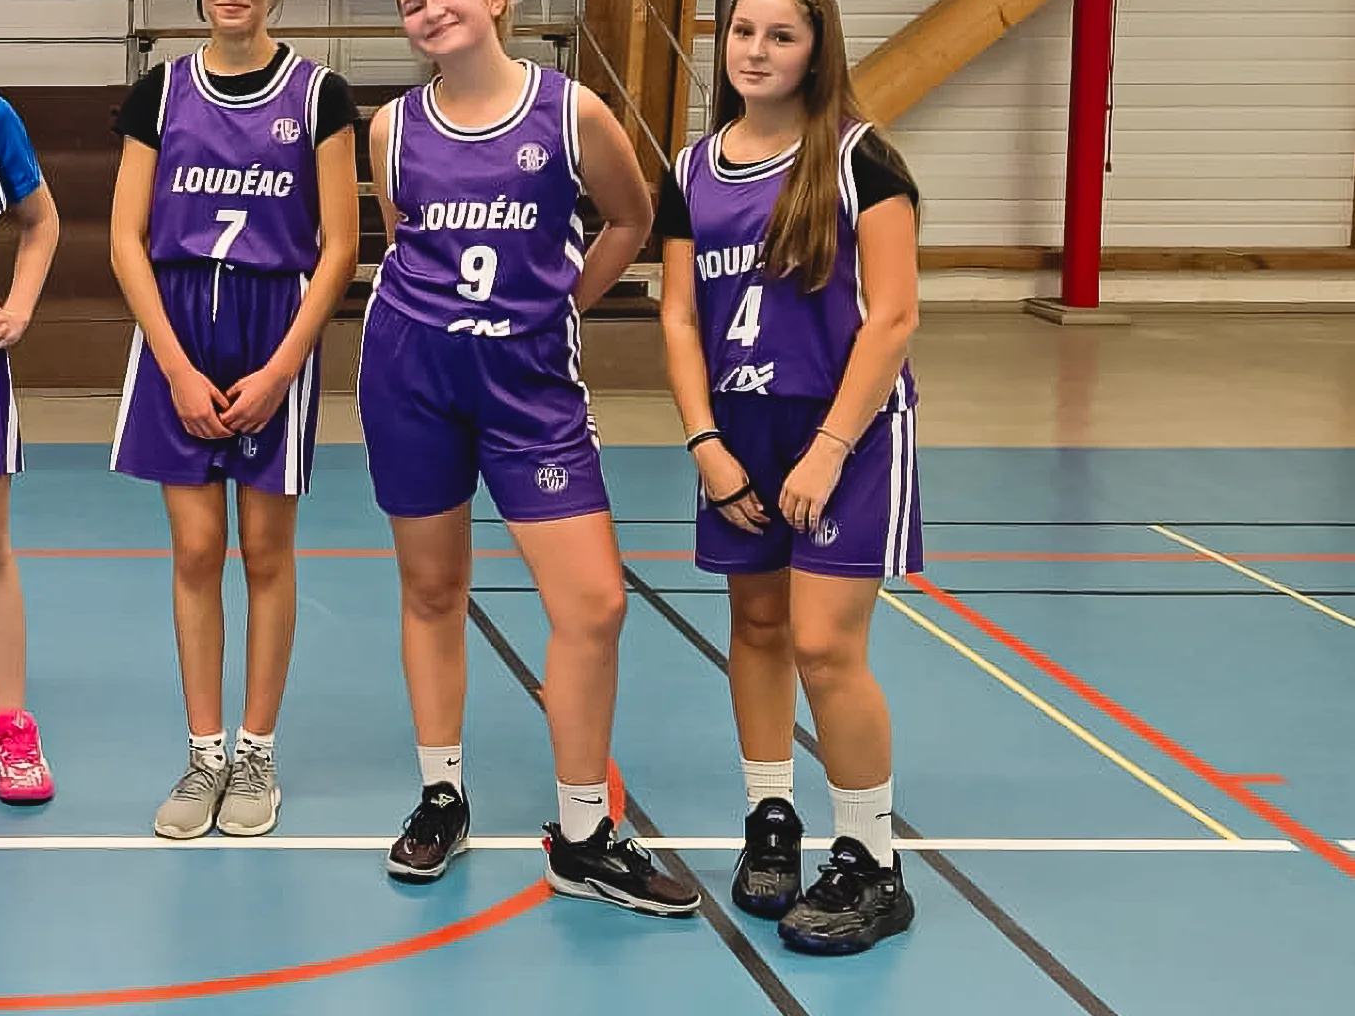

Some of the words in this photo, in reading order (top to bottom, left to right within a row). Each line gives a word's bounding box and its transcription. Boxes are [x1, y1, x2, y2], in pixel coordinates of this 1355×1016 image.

[172, 164, 294, 198] LOUDÉAC
[211, 209, 248, 260] 7
[457, 245, 497, 302] 9
[726, 285, 764, 347] 4
